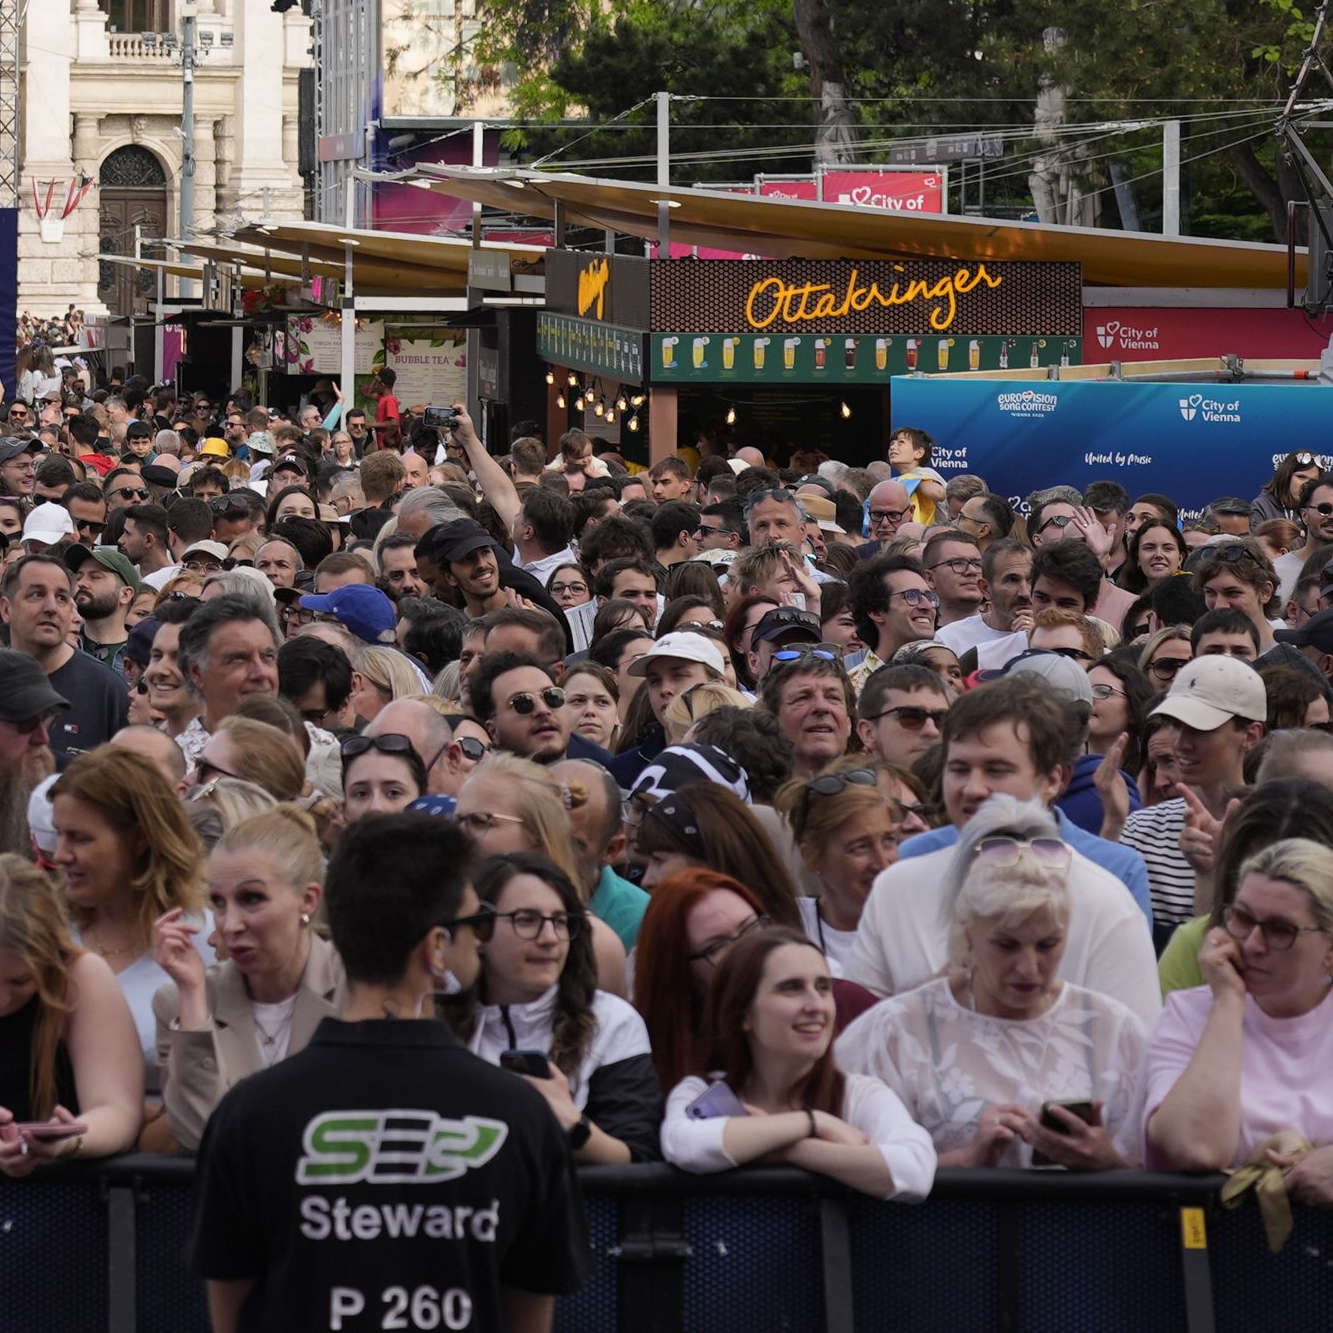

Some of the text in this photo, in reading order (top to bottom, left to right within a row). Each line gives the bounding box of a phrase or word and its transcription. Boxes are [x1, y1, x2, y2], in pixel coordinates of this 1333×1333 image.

[870, 193, 924, 210] City of
[746, 263, 1003, 330] Ottakringer
[1119, 326, 1158, 340] City of
[1119, 339, 1159, 350] Vienna
[394, 355, 450, 365] BUBBLE TEA
[997, 390, 1058, 405] EUROVISION
[999, 402, 1056, 412] SONG CONTEST
[1202, 400, 1240, 413] City of
[1202, 412, 1241, 423] Vienna
[932, 446, 967, 458] City of
[1085, 451, 1152, 466] United by Music
[931, 457, 968, 469] Vienna
[299, 1194, 500, 1243] Steward
[329, 1285, 473, 1331] P 260
